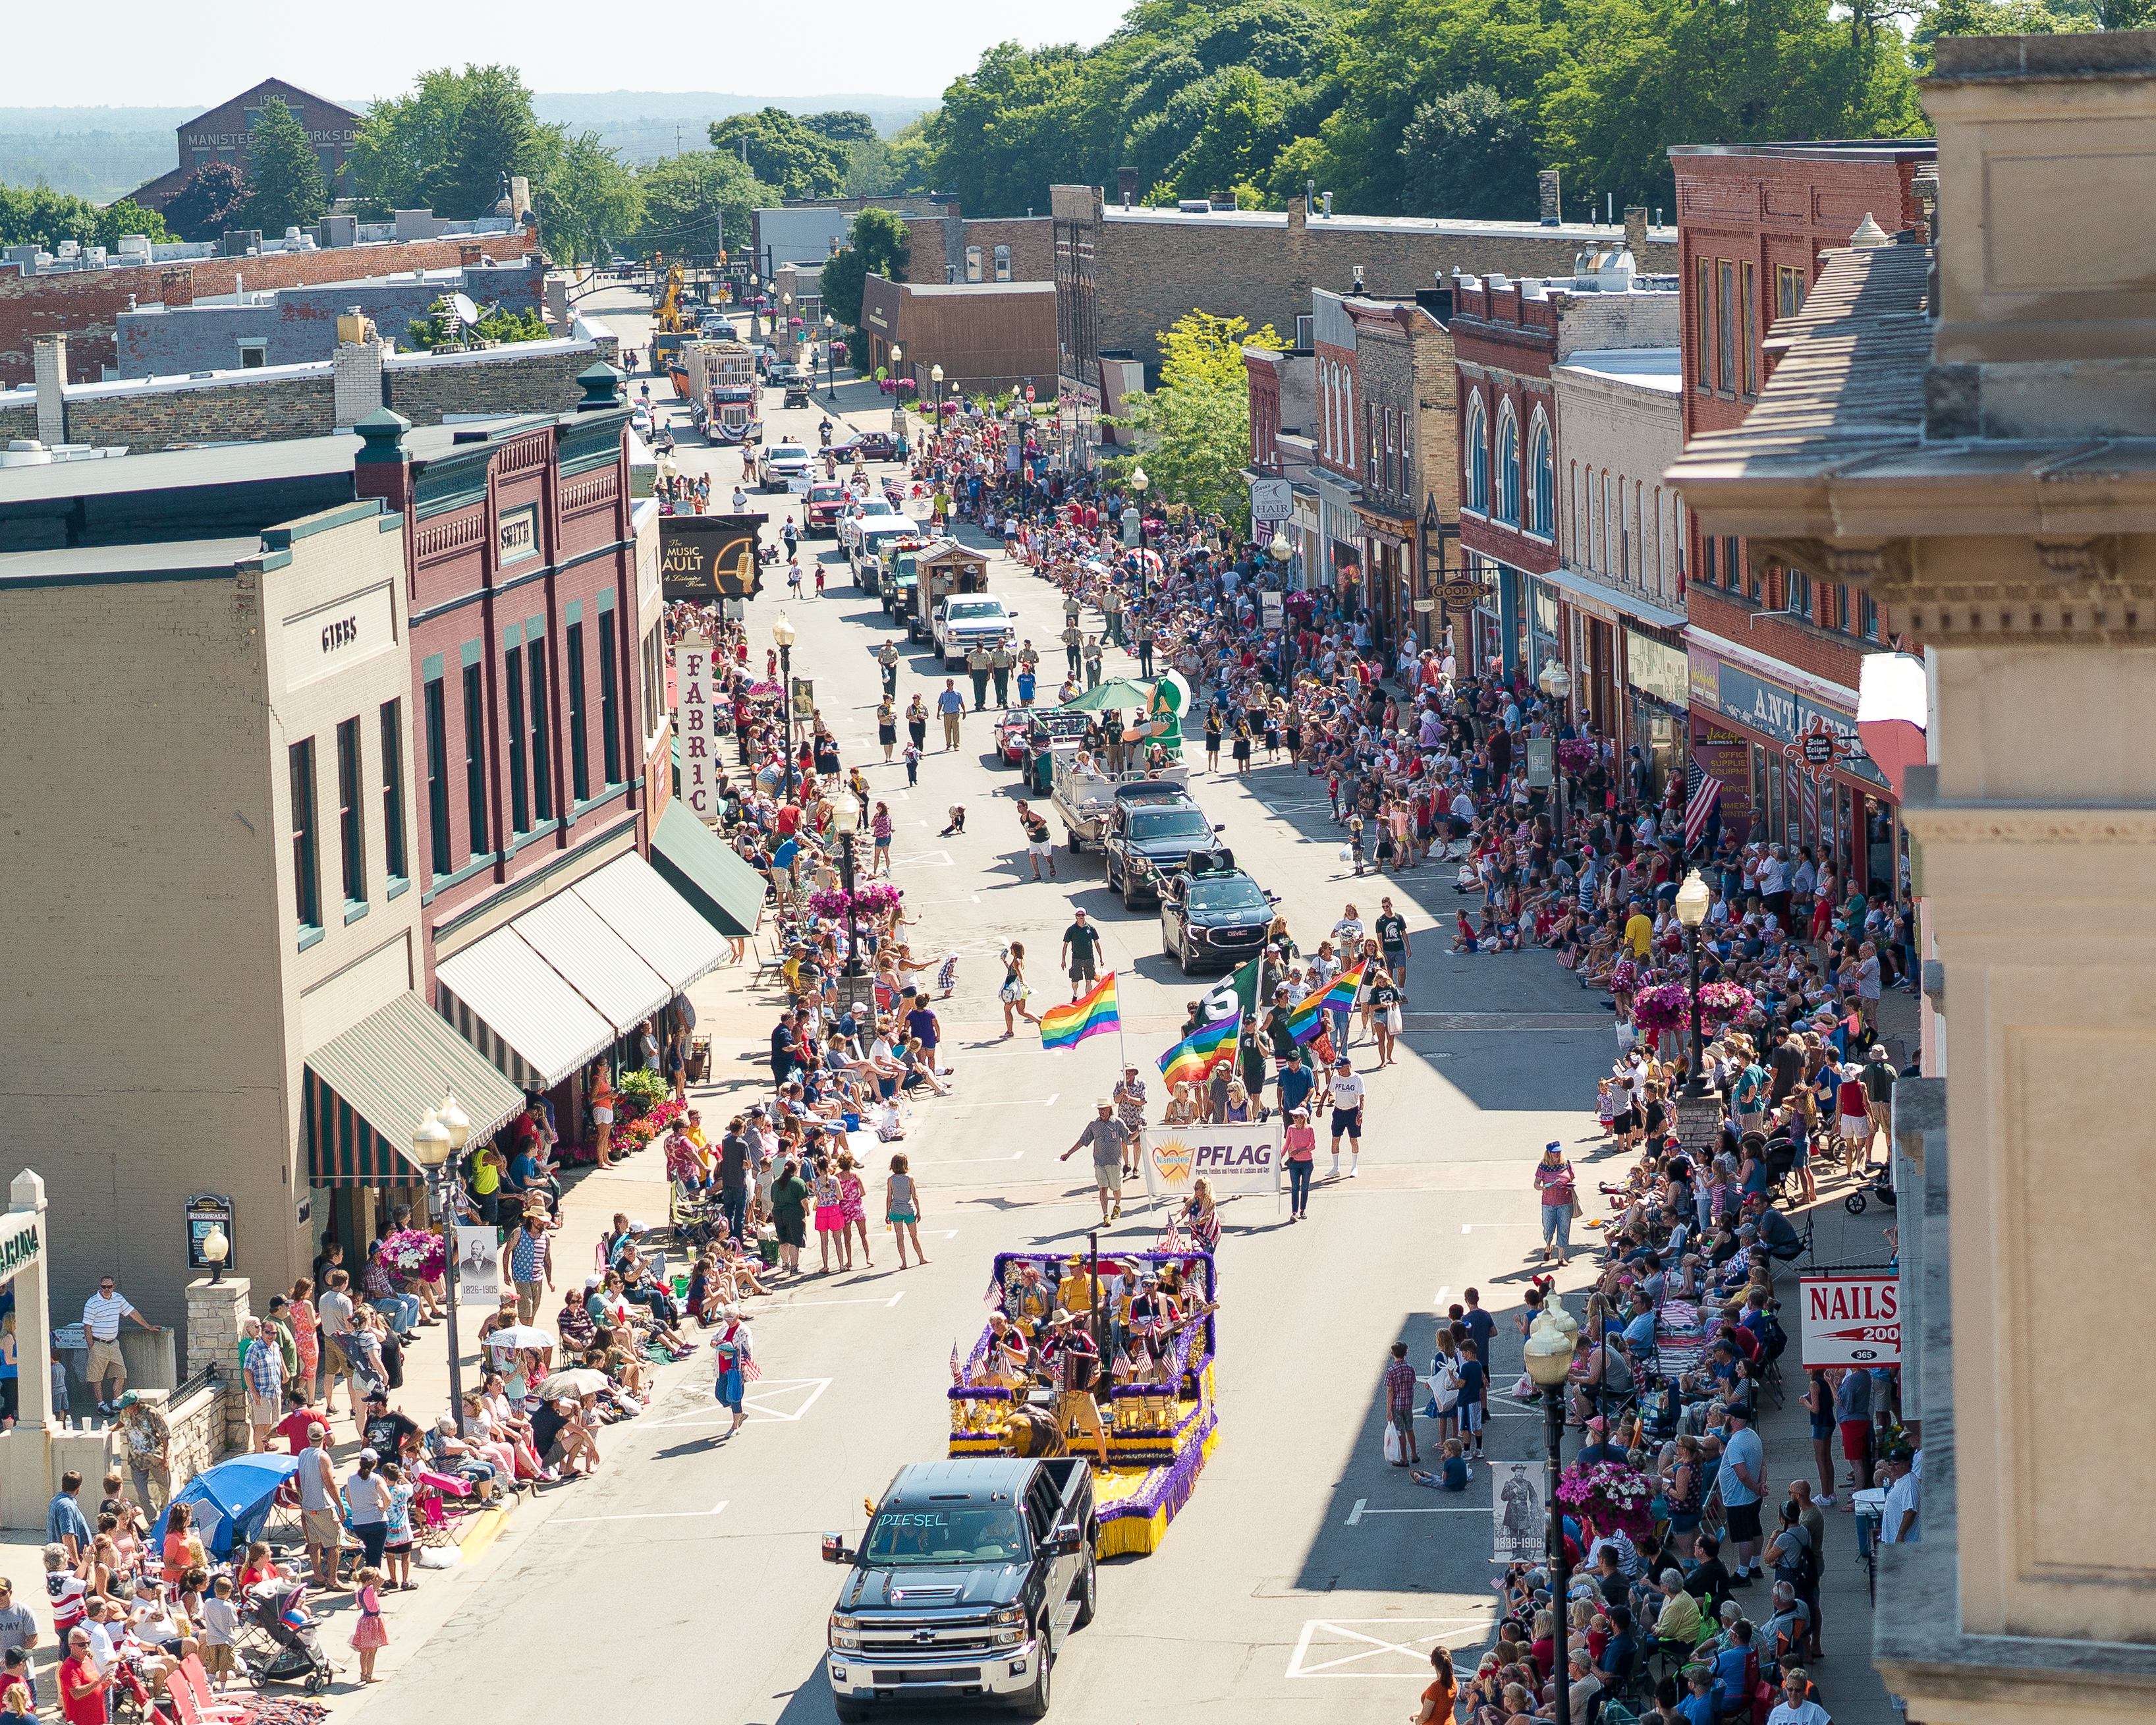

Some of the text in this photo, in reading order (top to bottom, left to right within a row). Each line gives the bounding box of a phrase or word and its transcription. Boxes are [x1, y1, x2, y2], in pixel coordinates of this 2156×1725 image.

[188, 133, 256, 145] MANISTEE
[305, 130, 340, 142] ORKS
[1256, 505, 1289, 513] HAIR
[667, 546, 700, 556] MUSIC
[661, 555, 704, 572] AULT
[1433, 584, 1486, 596] GOODY'S
[322, 614, 356, 654] GIBBS
[684, 654, 707, 811] FABRIC
[1806, 745, 1830, 754] Eclipse
[1379, 992, 1393, 1004] 23
[1157, 1155, 1190, 1164] Manistee
[1196, 1145, 1271, 1166] PFLAG
[463, 1285, 498, 1294] 1826-1905
[1810, 1285, 1897, 1320] NAILS
[879, 1513, 948, 1527] DIESEL
